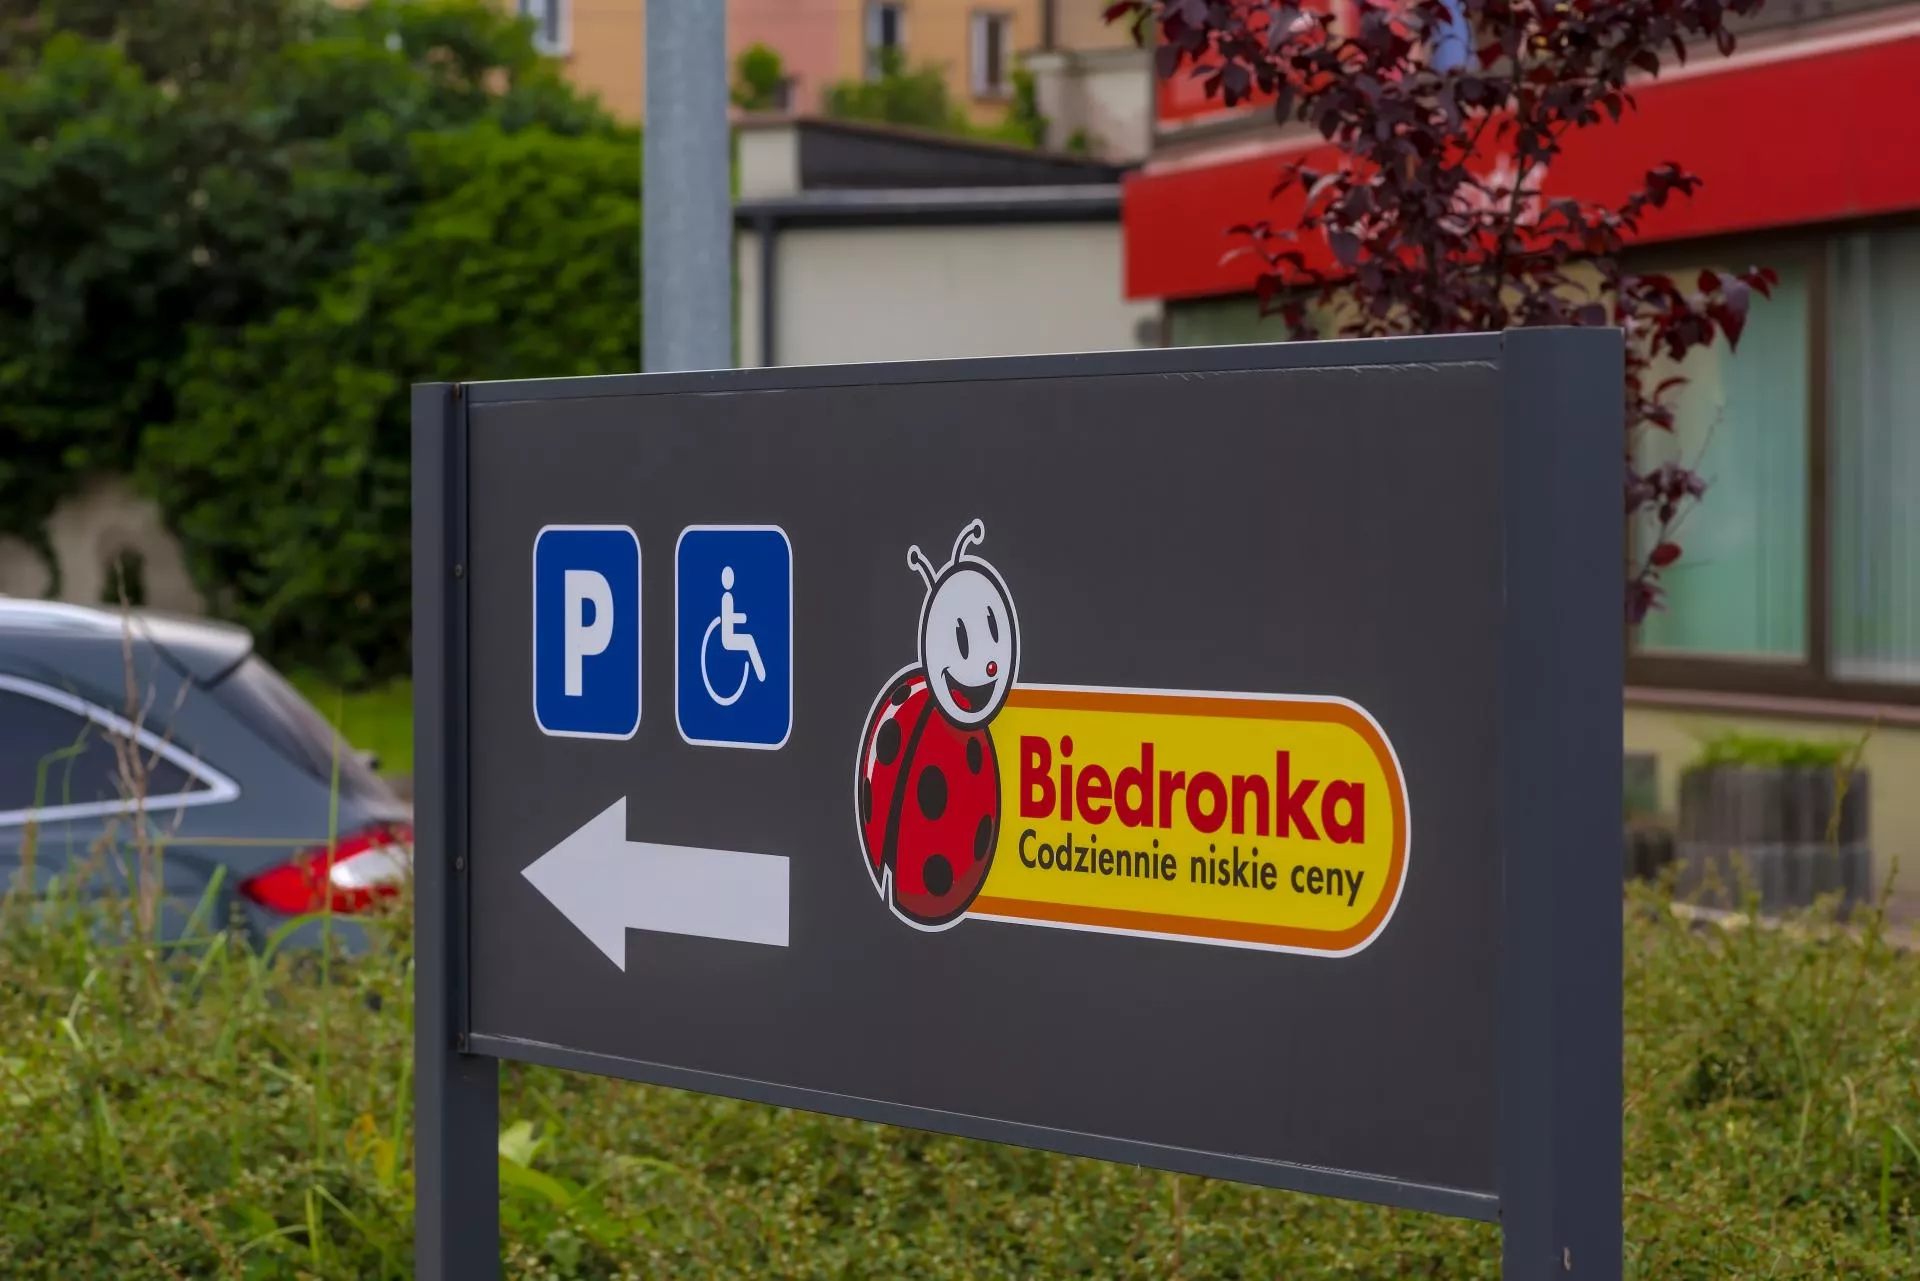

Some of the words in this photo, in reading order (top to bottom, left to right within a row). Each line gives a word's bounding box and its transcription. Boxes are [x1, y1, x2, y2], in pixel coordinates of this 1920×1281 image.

[564, 569, 615, 697] P
[1019, 734, 1366, 845] Biedronka
[1018, 828, 1177, 881] Codziennie
[1190, 843, 1278, 890] niskie
[1290, 864, 1365, 907] ceny
